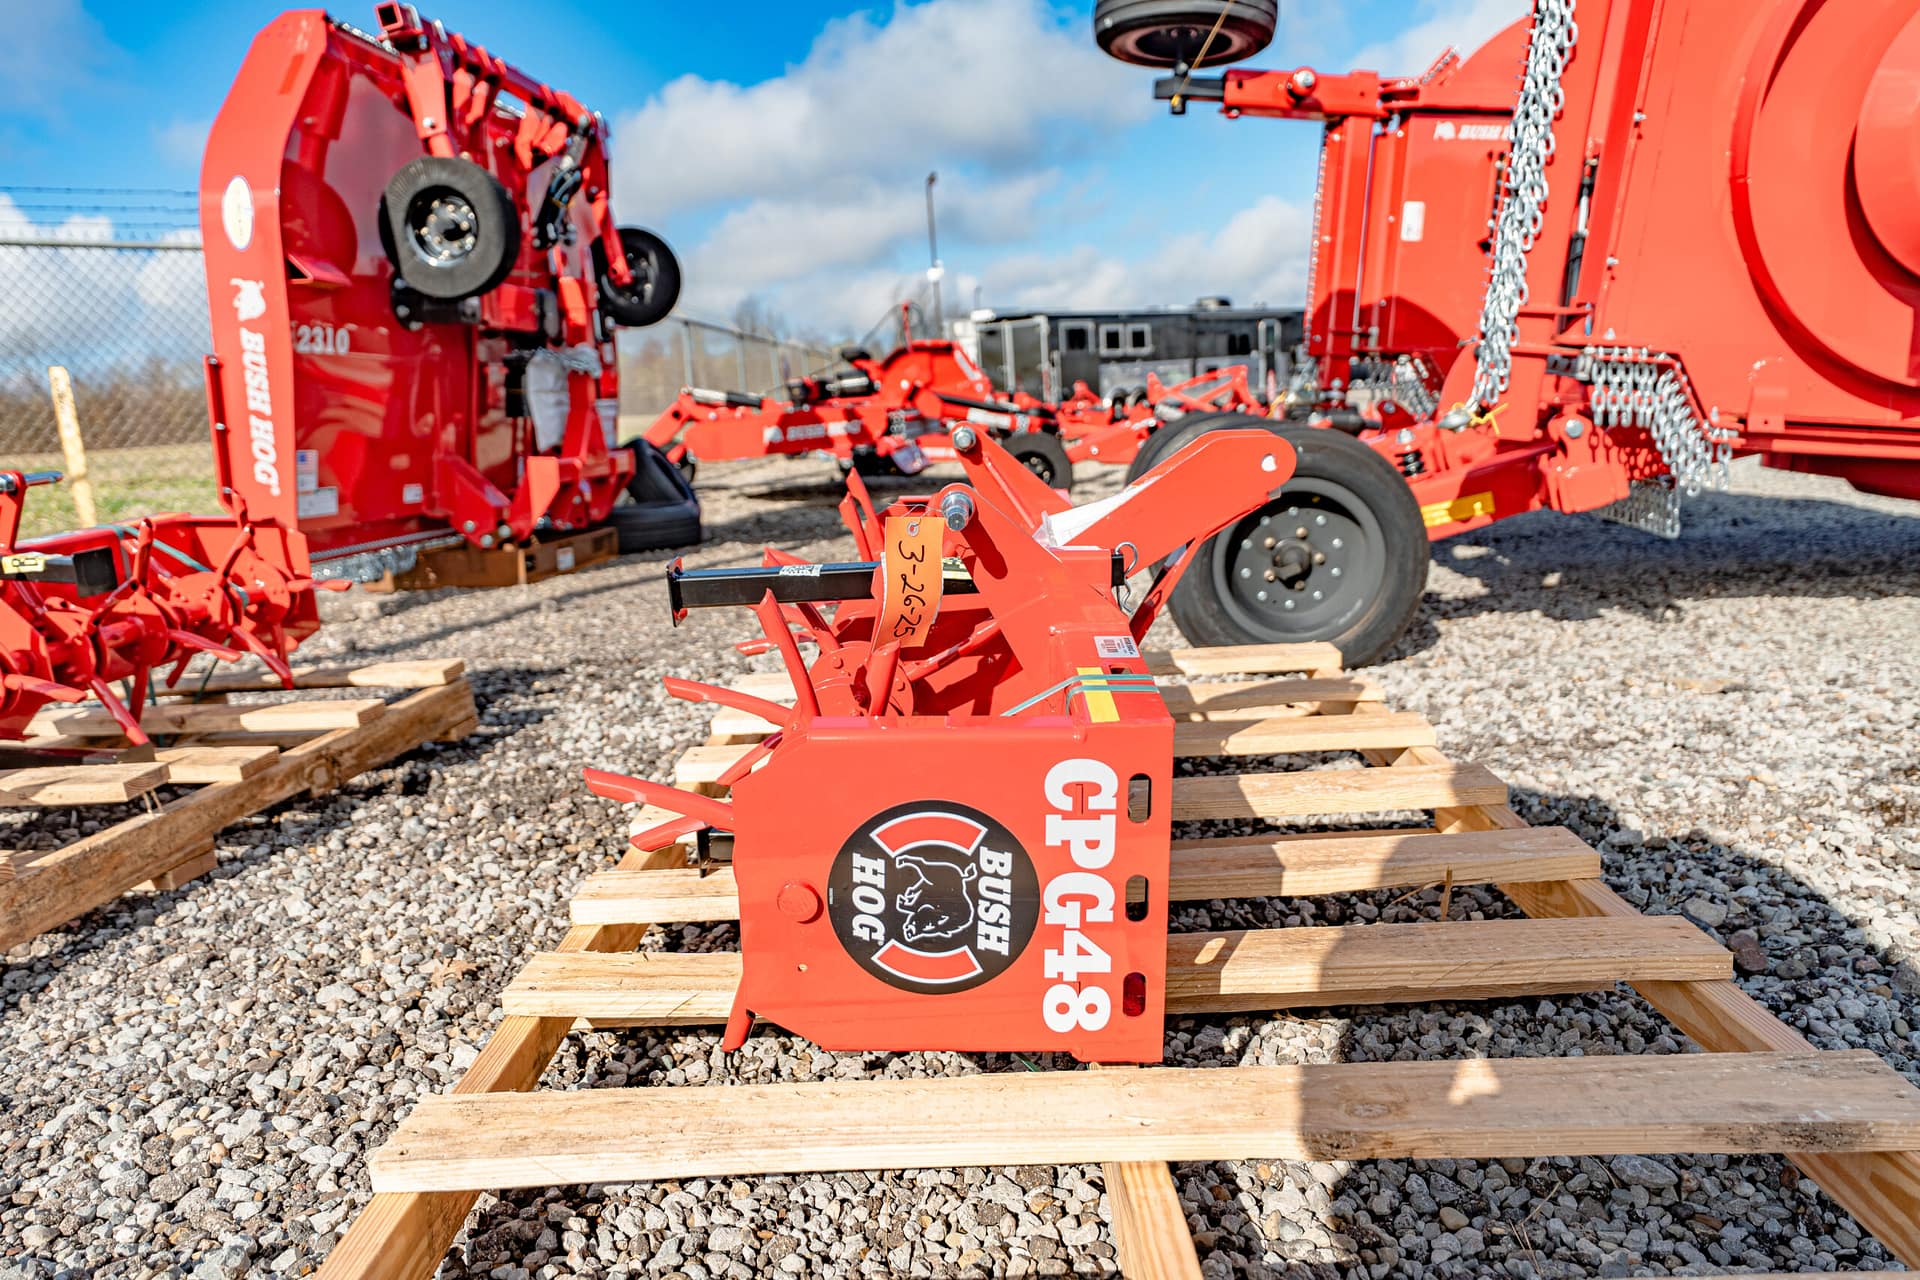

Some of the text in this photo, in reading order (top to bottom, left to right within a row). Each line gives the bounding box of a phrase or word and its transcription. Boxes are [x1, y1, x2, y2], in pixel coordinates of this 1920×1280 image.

[240, 327, 280, 490] BUSH HOG
[893, 540, 926, 638] 3-26-25
[851, 852, 887, 944] HOG
[976, 846, 1014, 957] BUSH
[1042, 758, 1120, 1034] CPG48
